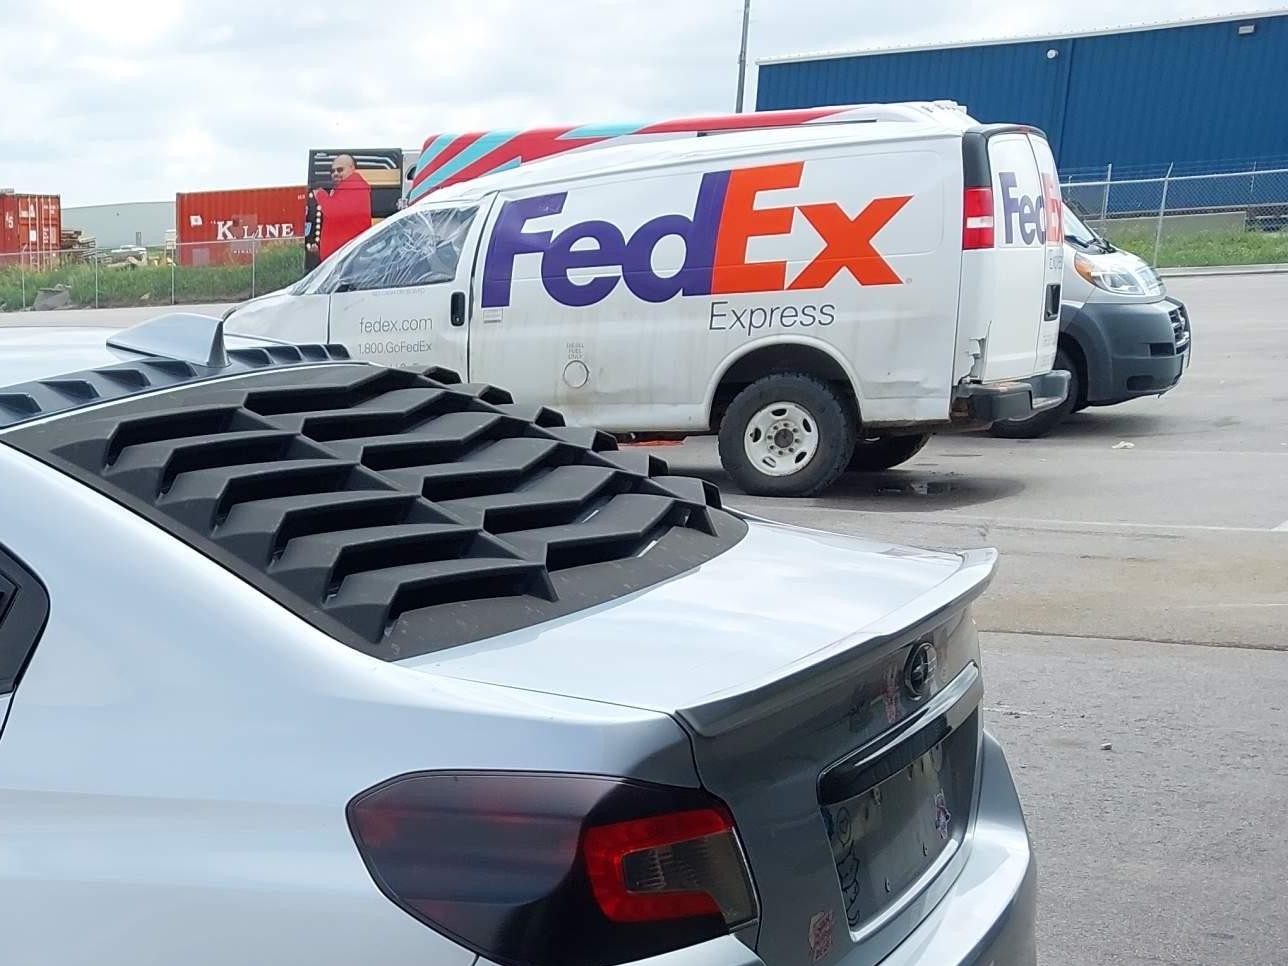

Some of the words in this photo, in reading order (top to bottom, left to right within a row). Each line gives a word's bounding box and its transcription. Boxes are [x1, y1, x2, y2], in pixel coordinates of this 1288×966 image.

[243, 223, 295, 239] LINE
[481, 161, 914, 308] FedEx
[360, 316, 433, 333] fedex.com
[709, 301, 835, 336] Express
[358, 340, 433, 355] 1.800.GoFedEx
